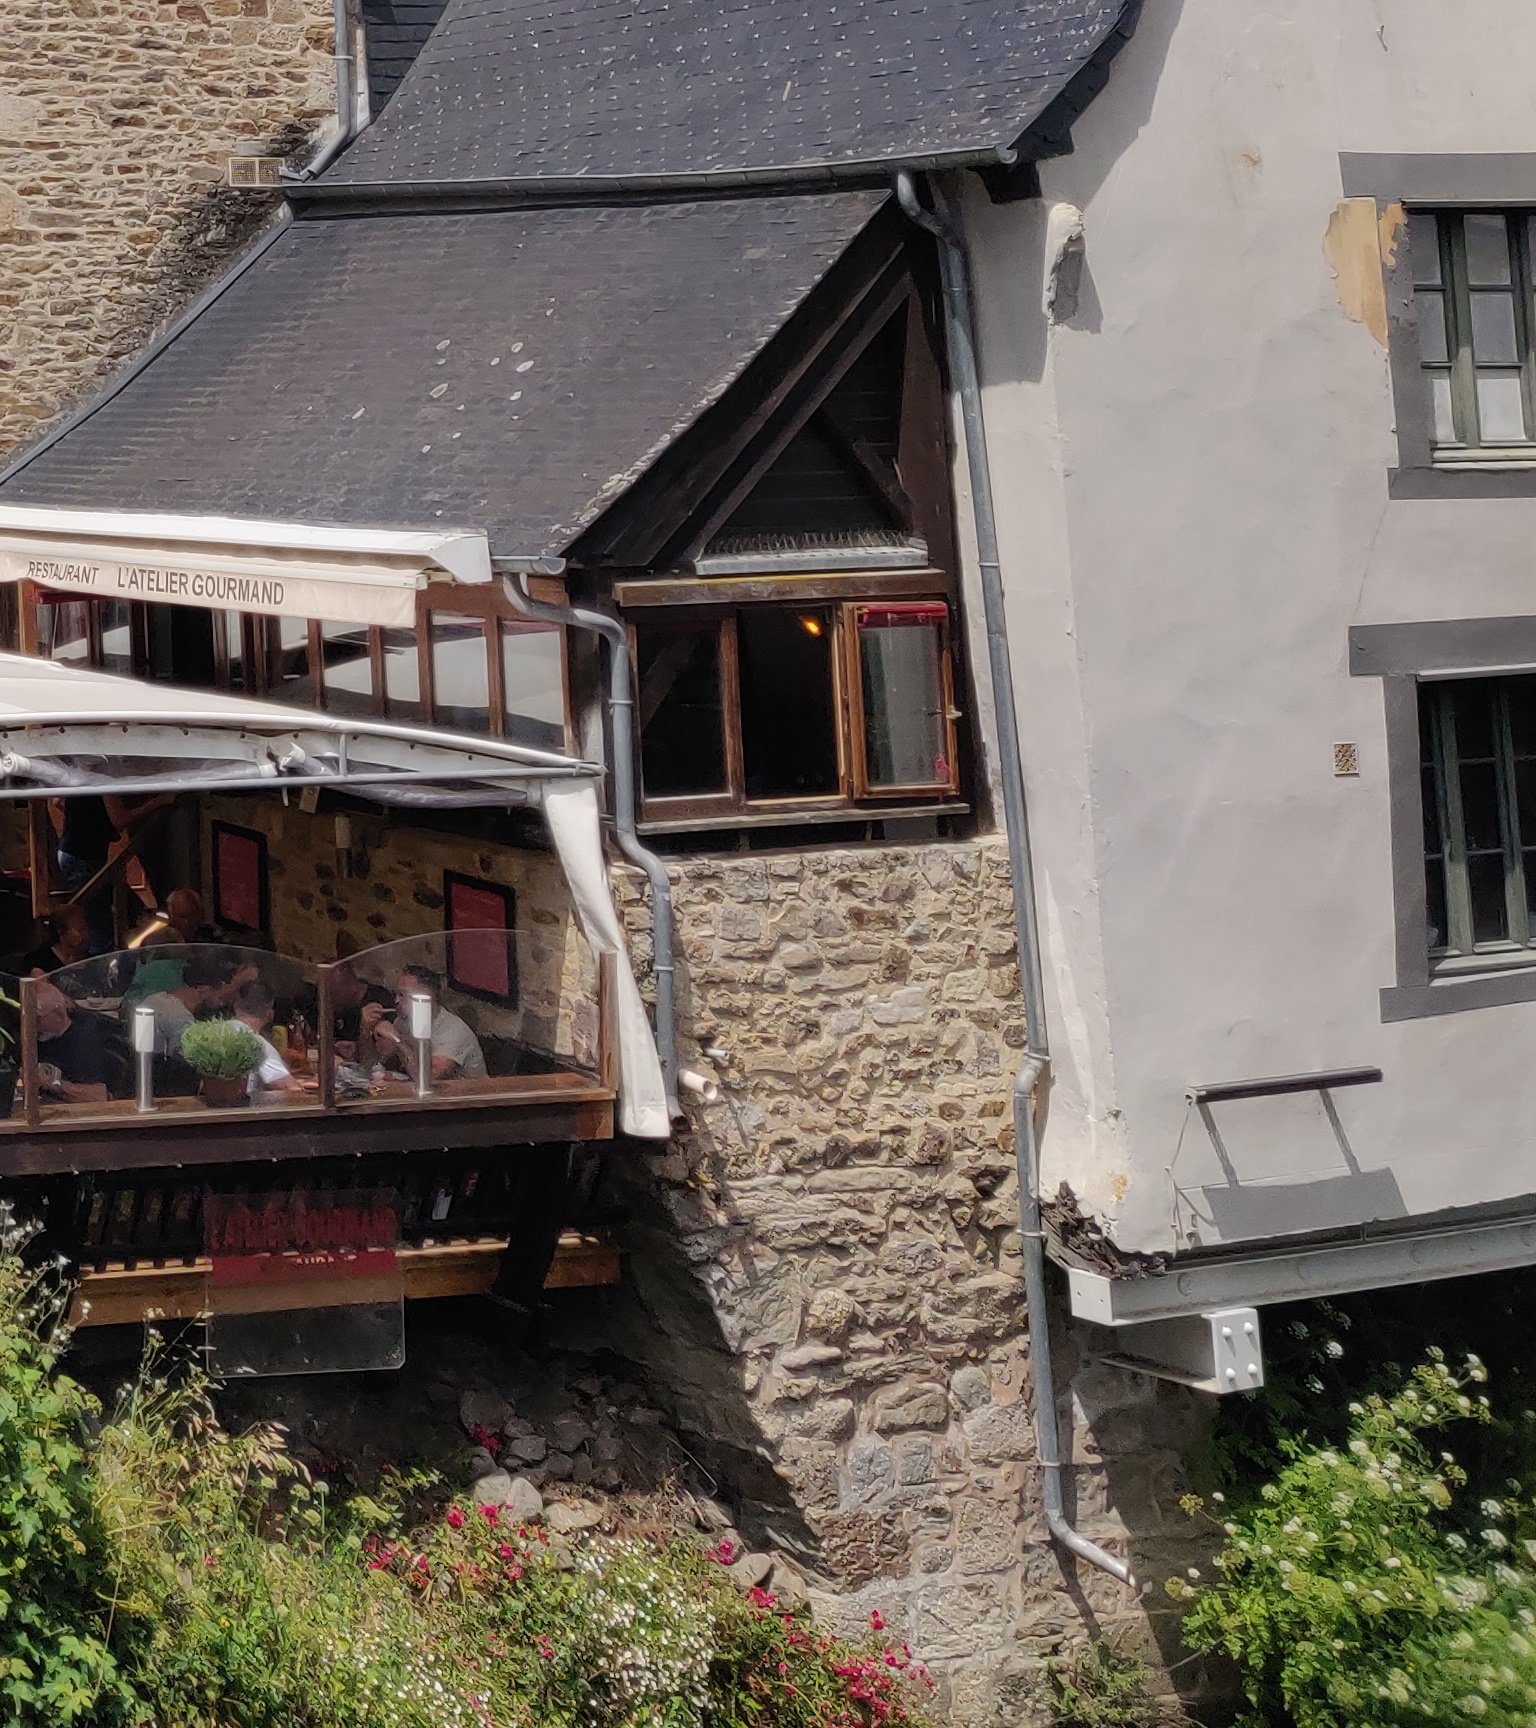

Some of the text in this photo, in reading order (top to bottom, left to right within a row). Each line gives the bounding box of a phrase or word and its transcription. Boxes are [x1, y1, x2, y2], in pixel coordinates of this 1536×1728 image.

[28, 560, 285, 606] RESTAURANT L'ATELIER GOURMAND
